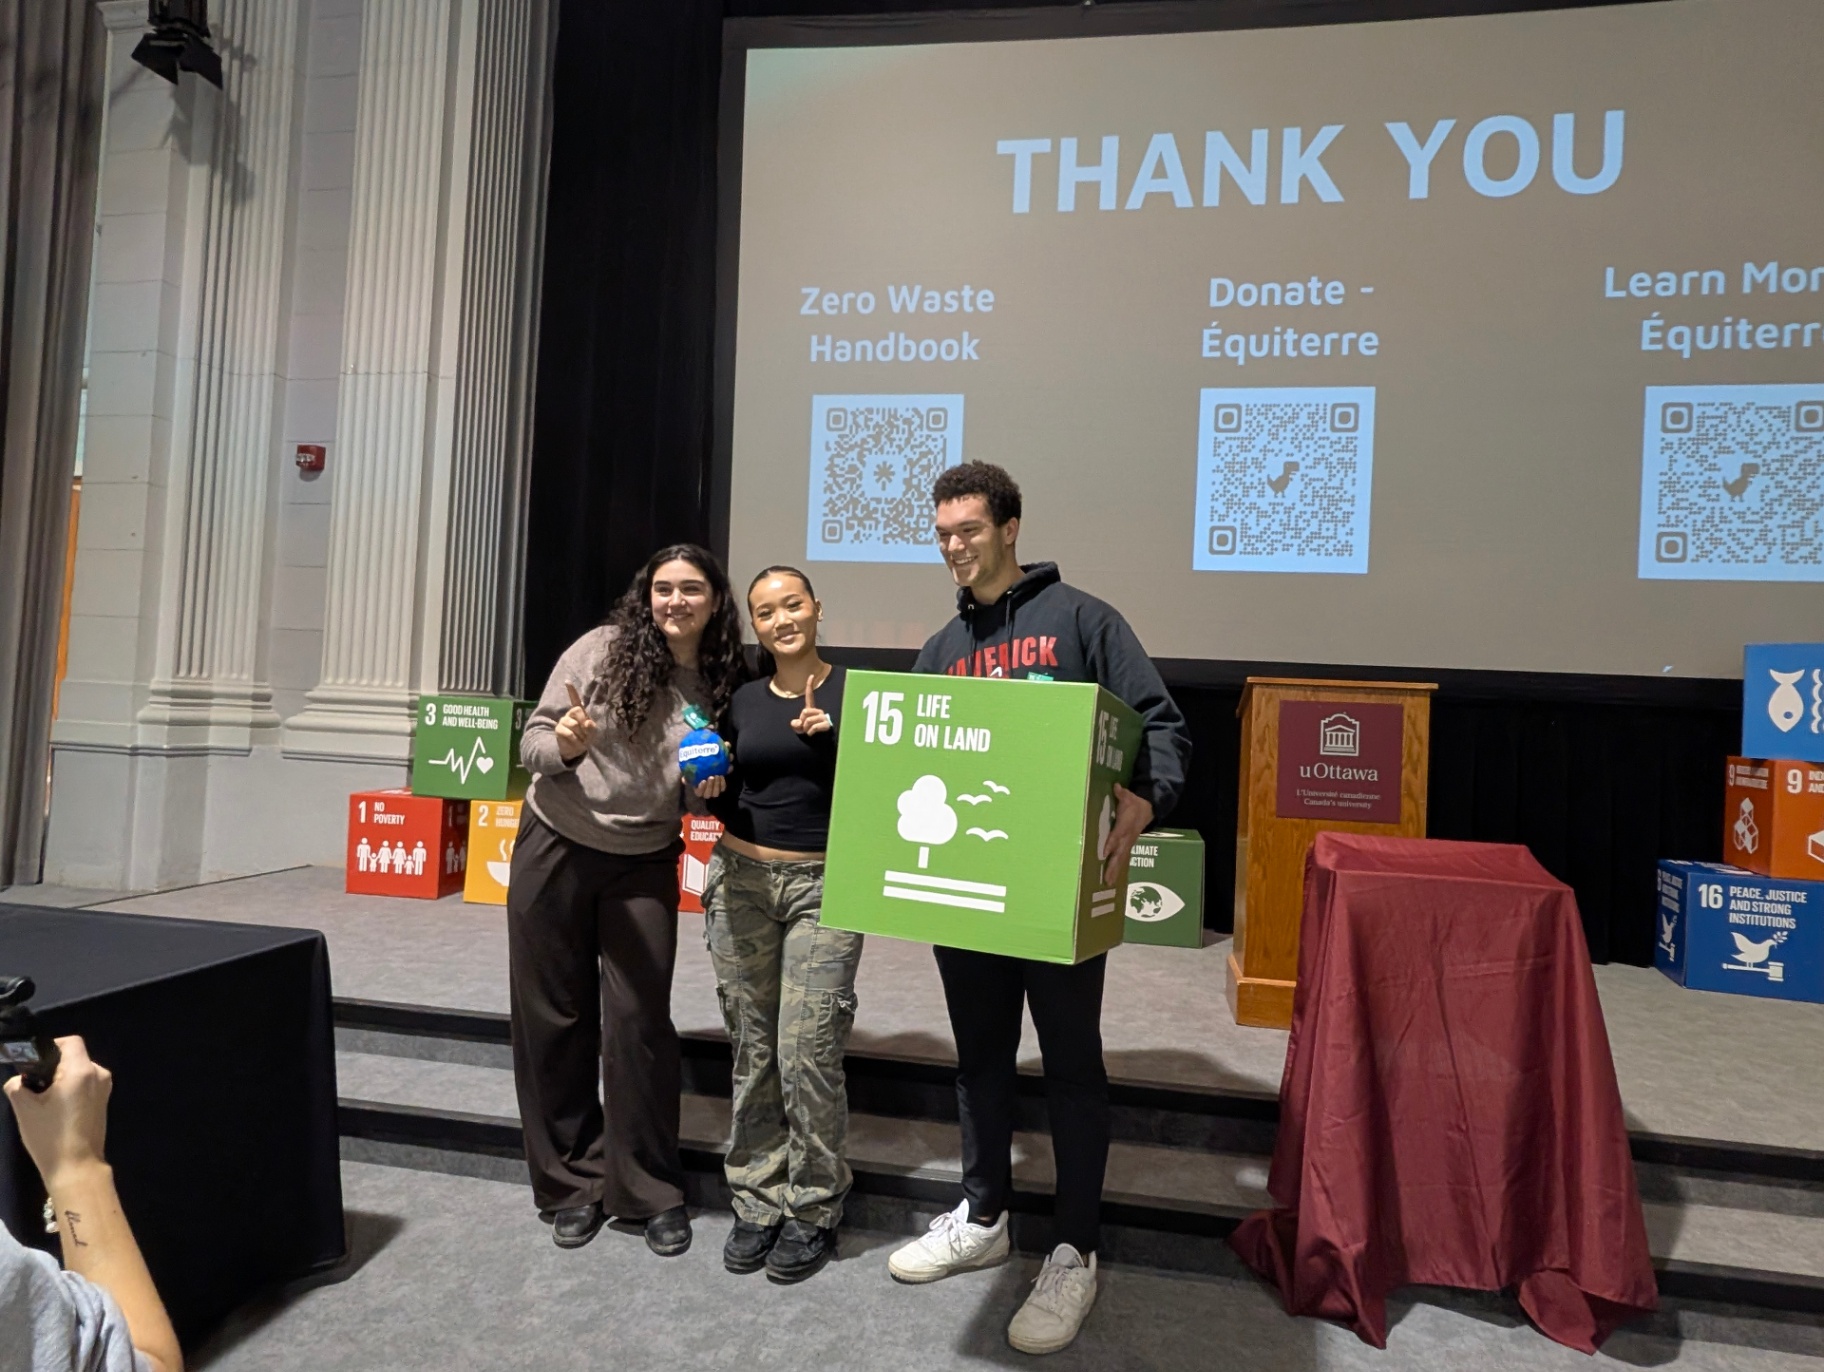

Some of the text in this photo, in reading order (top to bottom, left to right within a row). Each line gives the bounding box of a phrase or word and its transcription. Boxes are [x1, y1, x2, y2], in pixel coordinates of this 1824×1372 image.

[996, 110, 1625, 214] THANK YOU
[1209, 276, 1345, 307] Donate
[1604, 267, 1726, 298] Learn
[801, 284, 995, 315] Zero Waste
[809, 331, 981, 362] Handbook
[1201, 321, 1379, 365] Équiterre
[1641, 312, 1824, 358] Équiterr
[425, 703, 437, 726] 3
[442, 704, 490, 717] GOOD HEALTH
[862, 690, 904, 745] 15
[917, 693, 952, 719] LIFE
[442, 716, 499, 730] AND WELL-BEING
[914, 723, 991, 752] ON LAND
[1786, 768, 1803, 794] 9
[358, 801, 367, 823] 1
[374, 802, 385, 812] NO
[374, 813, 406, 825] POVERTY
[478, 804, 489, 827] 2
[691, 819, 721, 831] QUALITY
[1698, 883, 1723, 909] 16
[1729, 899, 1792, 915] AND STRONG
[1766, 889, 1808, 903] JUSTICE
[1729, 912, 1797, 930] INSTITUTIONS
